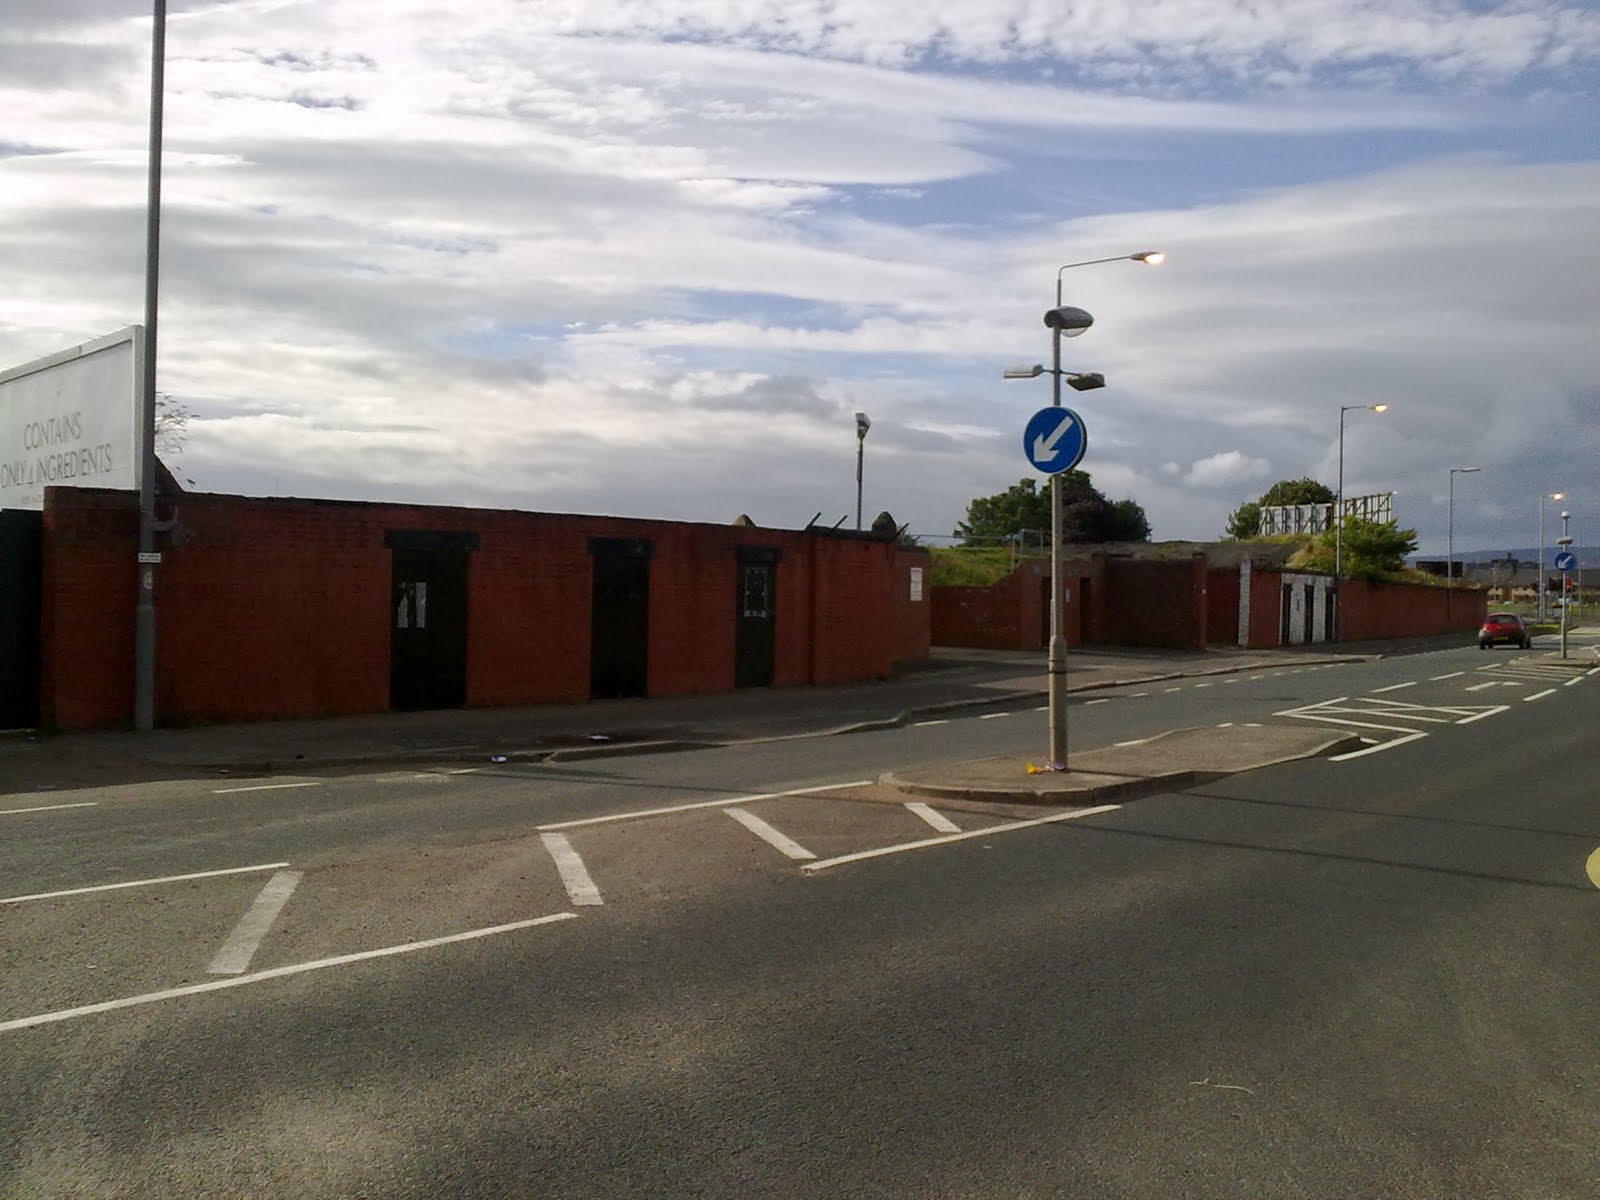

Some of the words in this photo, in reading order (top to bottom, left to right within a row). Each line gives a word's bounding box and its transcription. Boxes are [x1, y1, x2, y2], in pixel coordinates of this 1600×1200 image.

[24, 411, 81, 451] CONTAINS
[1, 457, 25, 488] ONLY
[37, 443, 112, 482] INGREDIENTS
